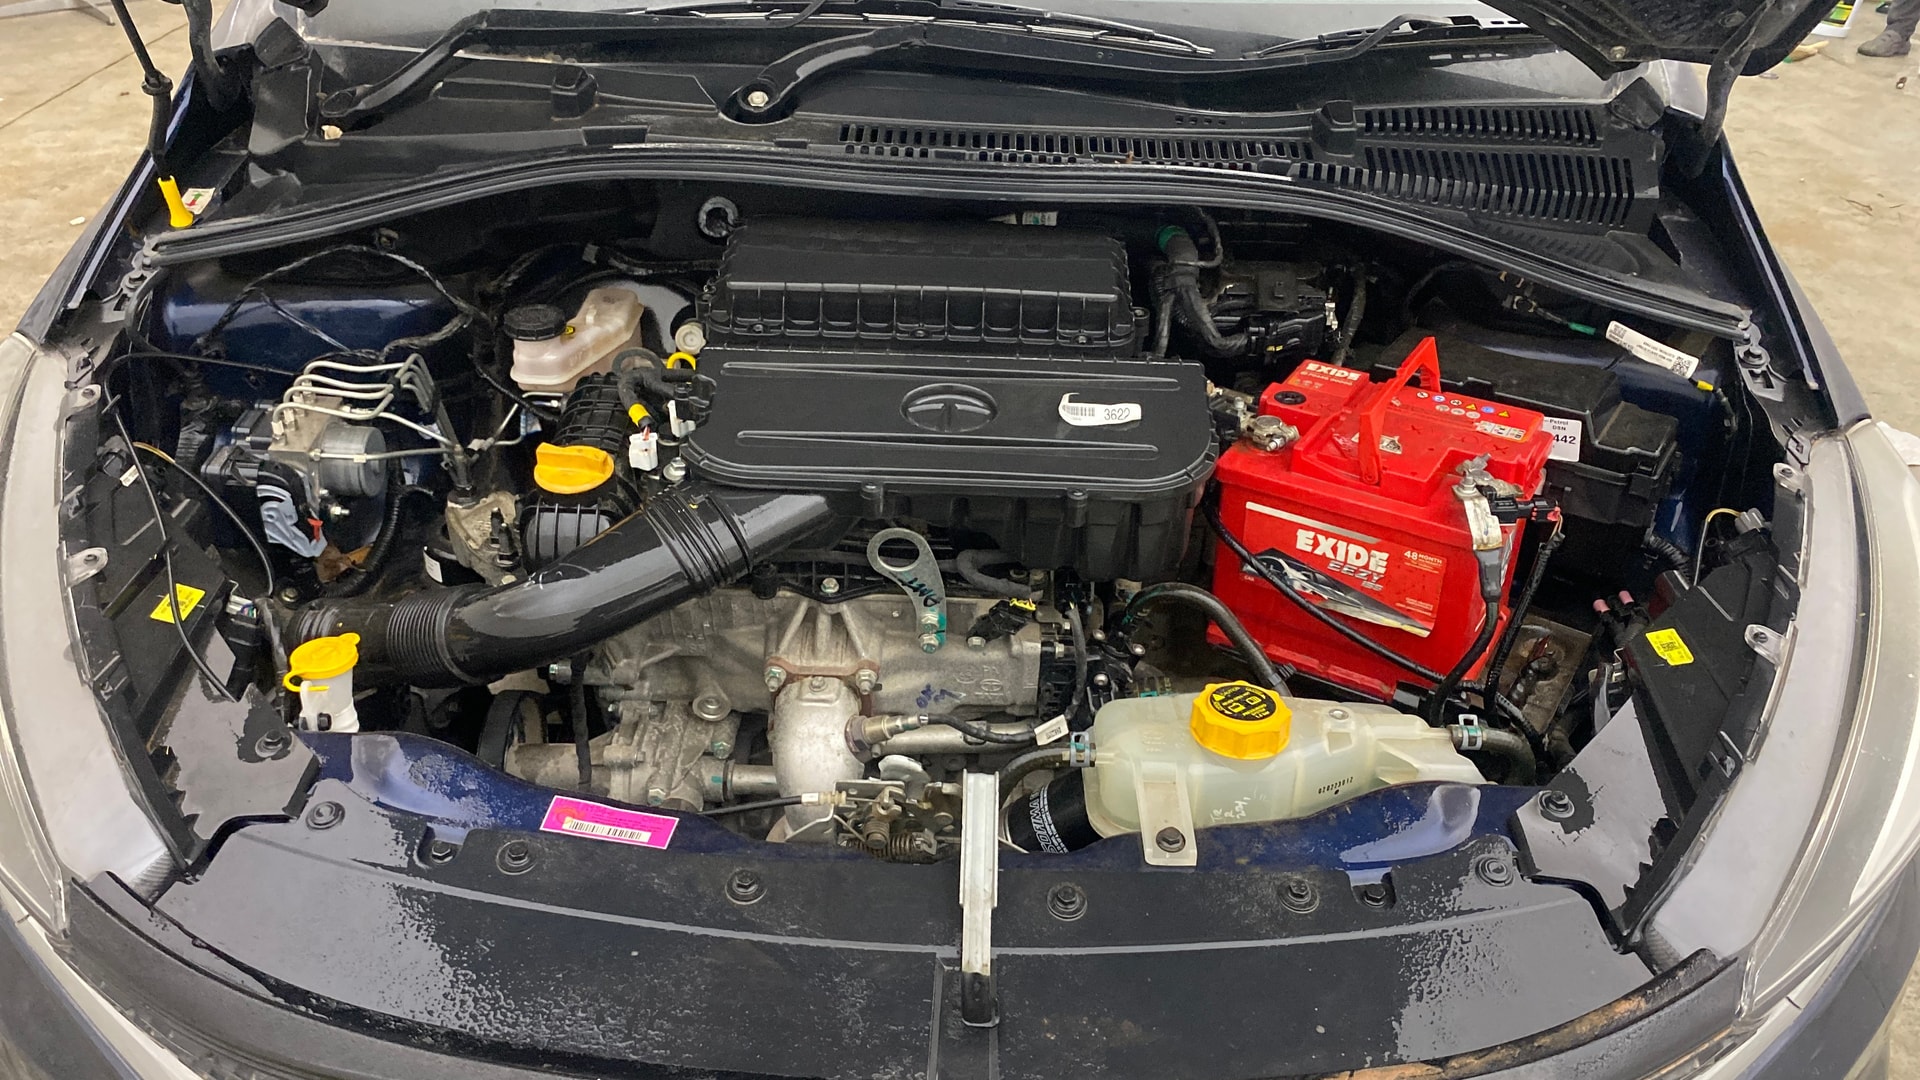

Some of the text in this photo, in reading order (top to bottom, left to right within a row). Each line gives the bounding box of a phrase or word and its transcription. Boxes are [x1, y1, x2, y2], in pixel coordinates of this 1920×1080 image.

[1306, 363, 1361, 380] EXIDE
[1104, 407, 1130, 421] 3622
[1296, 529, 1389, 574] EXIDE
[1404, 550, 1443, 564] 48 MONTH
[1327, 560, 1384, 583] EEZY
[1028, 797, 1058, 853] SOFIMA
